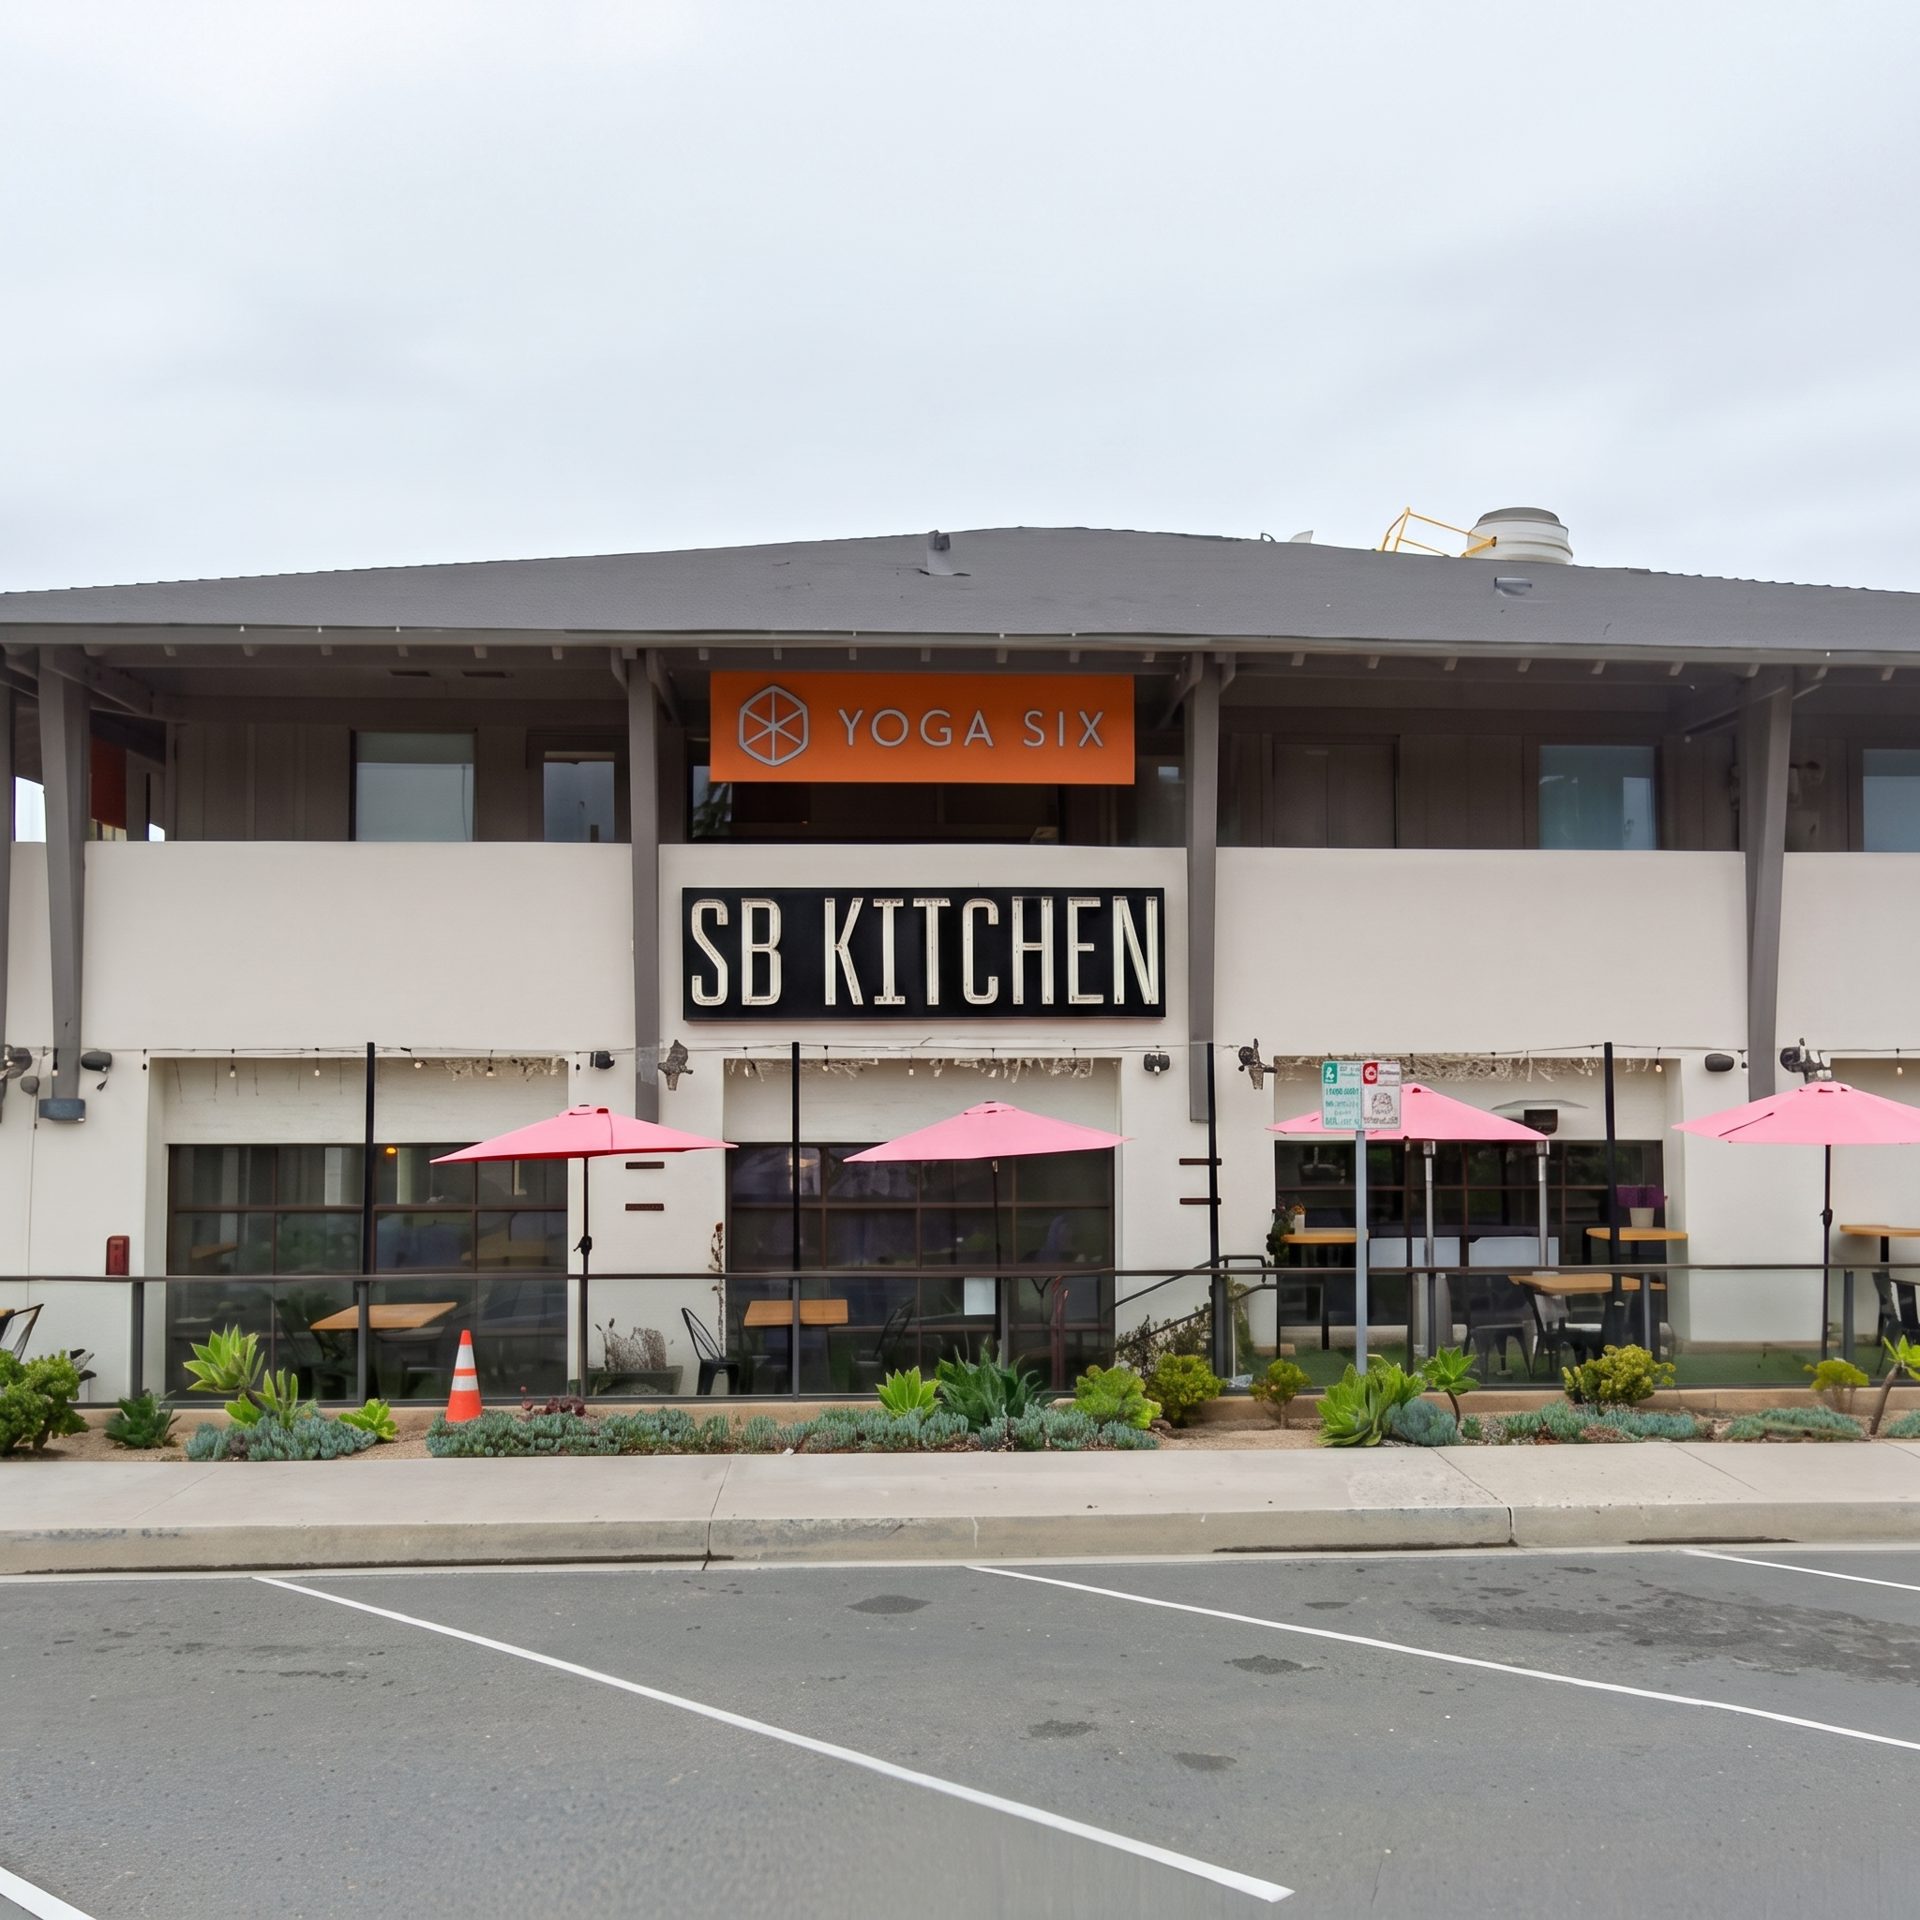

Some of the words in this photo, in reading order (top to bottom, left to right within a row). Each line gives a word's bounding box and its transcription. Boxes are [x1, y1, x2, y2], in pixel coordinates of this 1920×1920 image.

[838, 708, 994, 748] YOGA
[1023, 709, 1105, 748] SIX
[691, 897, 782, 1006] SB
[824, 895, 1160, 1006] KITCHEN
